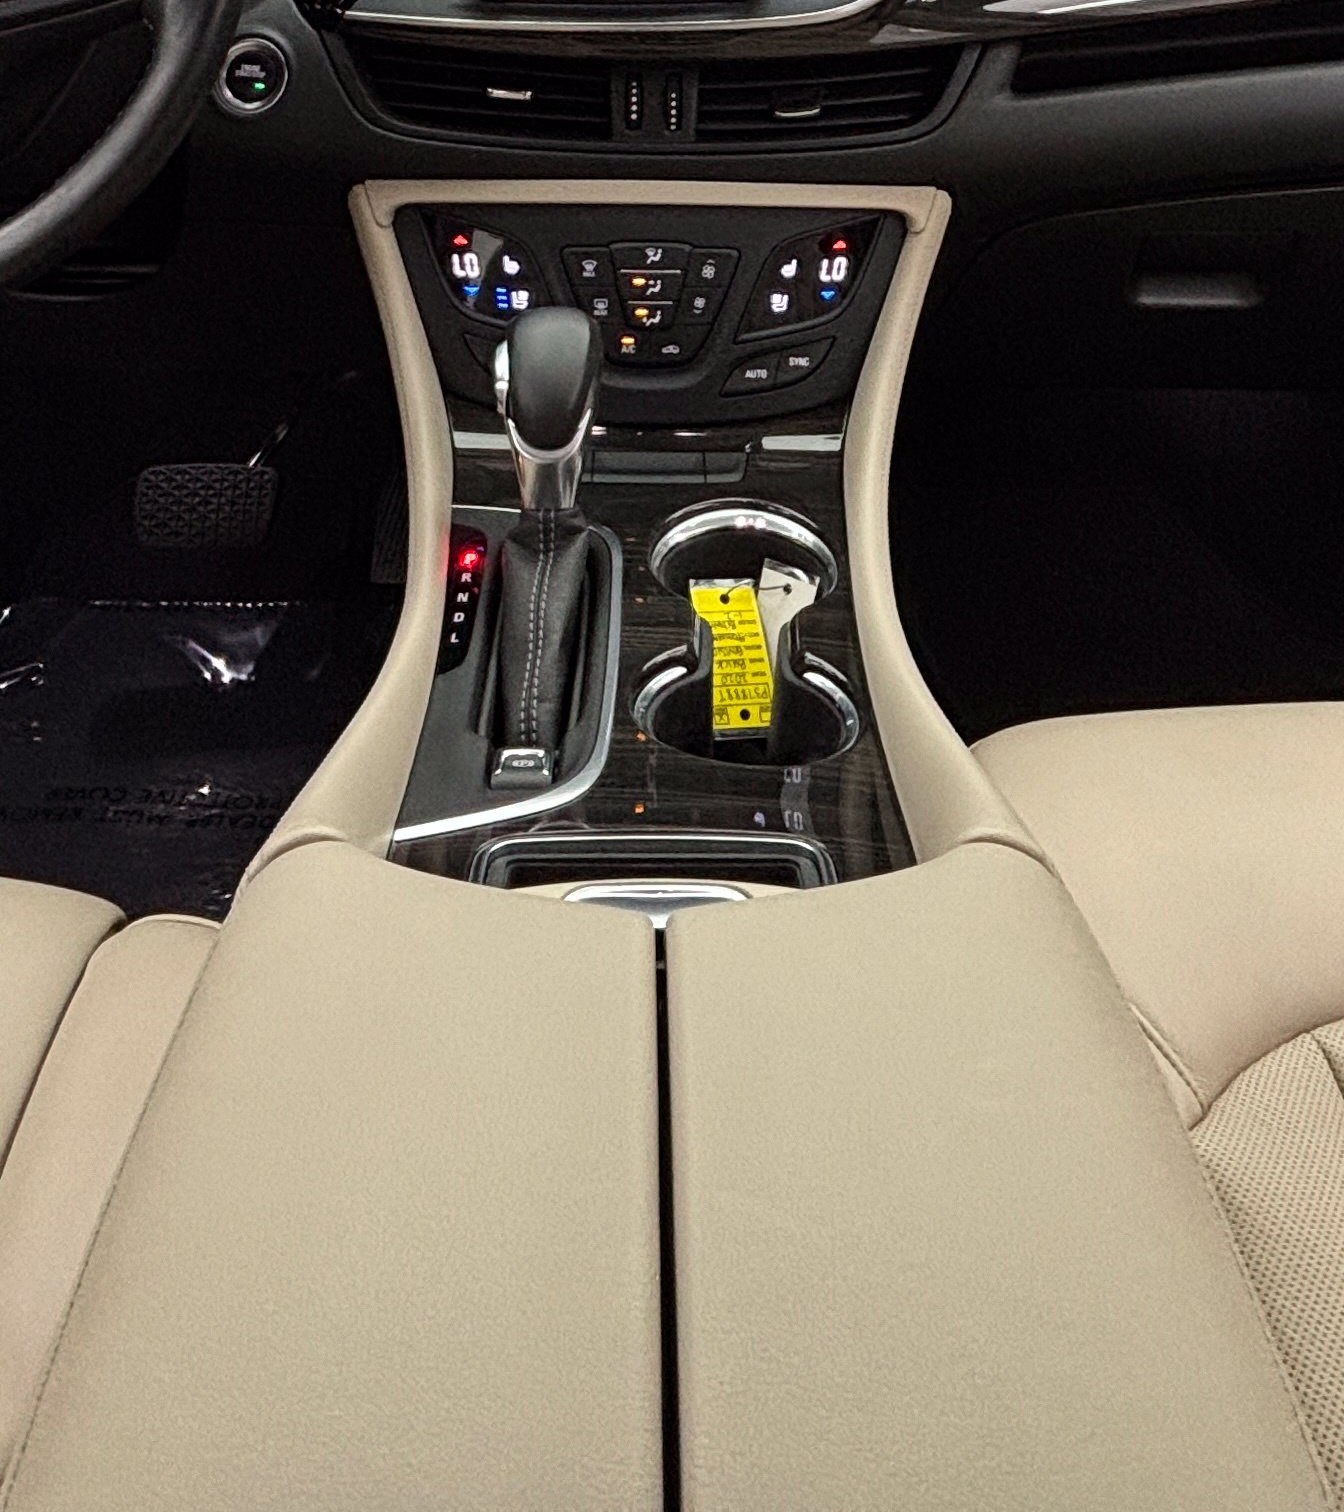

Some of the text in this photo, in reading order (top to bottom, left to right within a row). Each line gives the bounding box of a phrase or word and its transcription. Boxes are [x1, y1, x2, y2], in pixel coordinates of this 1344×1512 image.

[620, 344, 637, 355] A/C
[788, 356, 811, 367] SYNC
[744, 368, 768, 379] AUTO
[460, 571, 473, 584] R
[456, 591, 470, 603] N
[452, 611, 466, 623] D
[449, 631, 460, 644] L
